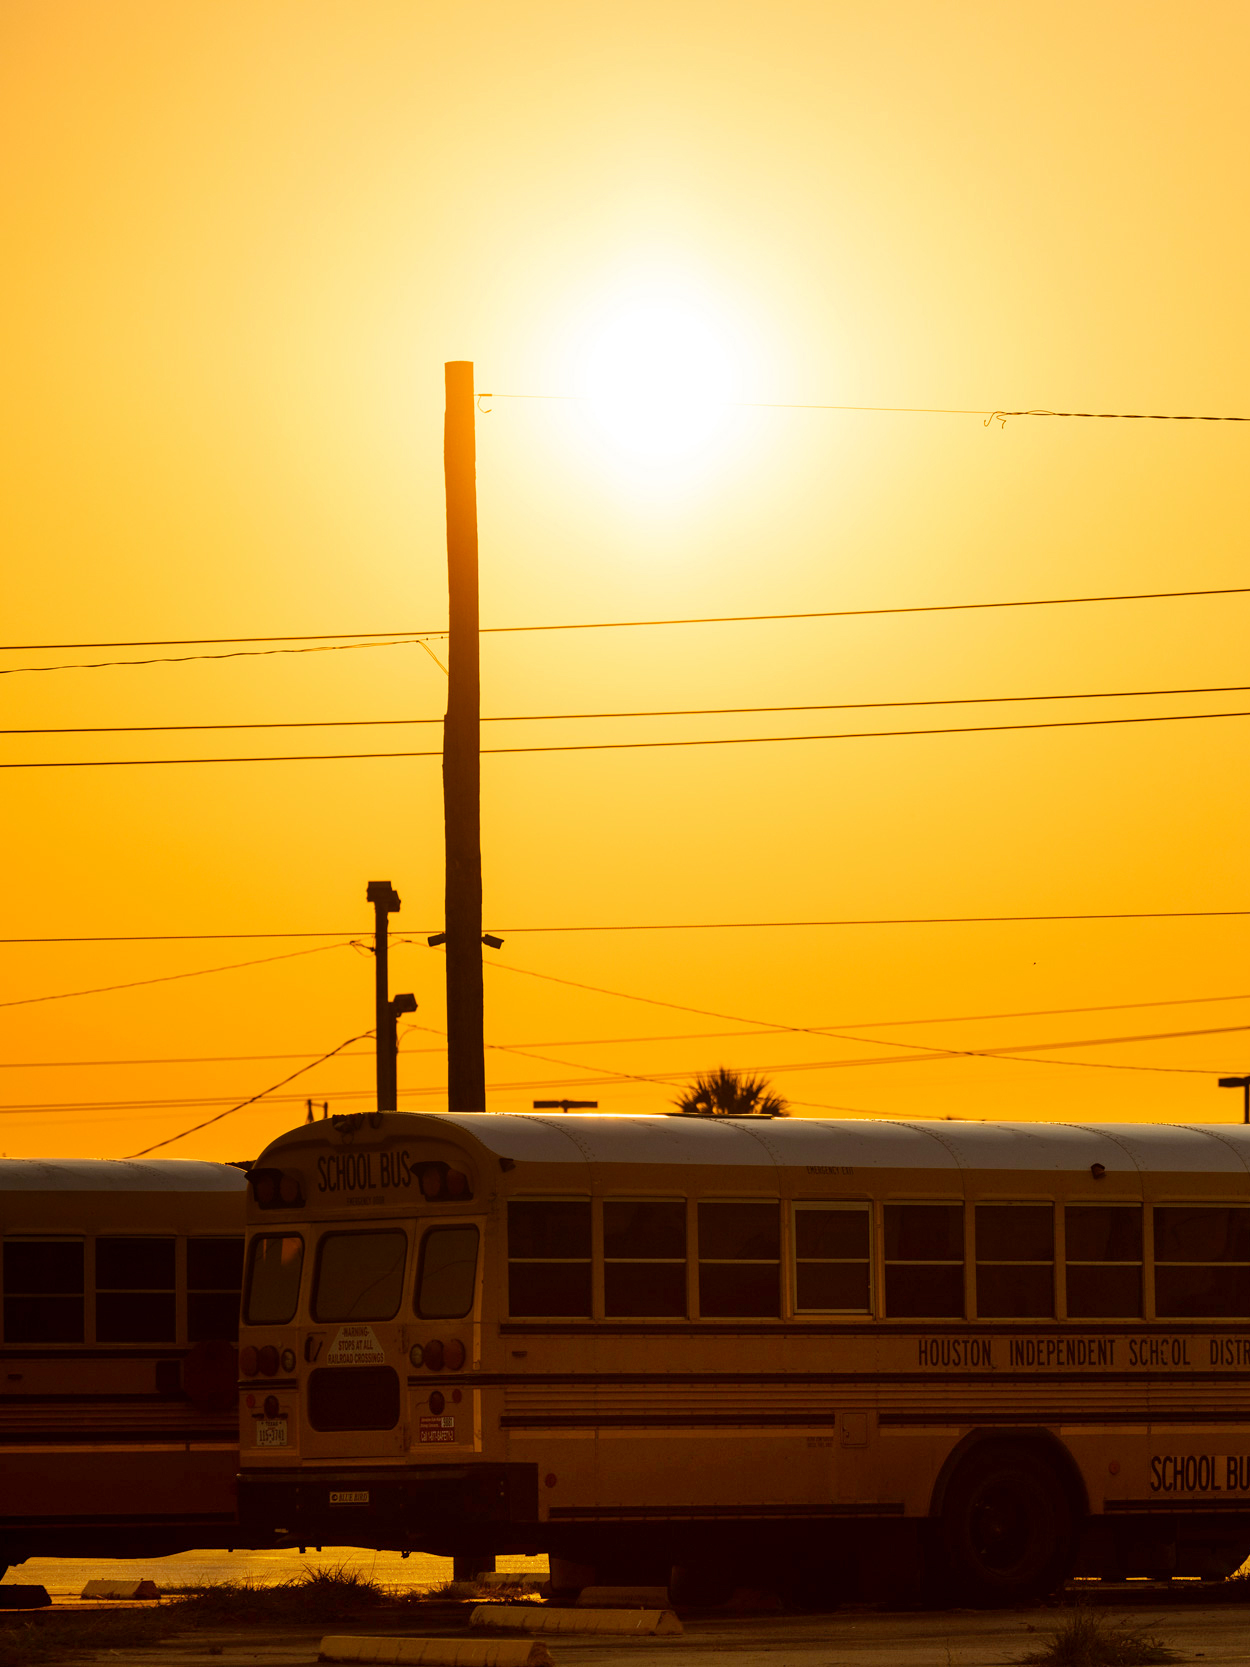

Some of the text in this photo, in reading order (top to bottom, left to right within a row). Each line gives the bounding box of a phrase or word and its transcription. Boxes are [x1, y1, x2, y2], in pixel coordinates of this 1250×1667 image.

[317, 1150, 411, 1192] SCHOOL BUS
[806, 1165, 840, 1175] EMERGENCY
[338, 1340, 374, 1351] STOPS AT ALL
[918, 1338, 992, 1367] HOUSTON
[1009, 1339, 1116, 1366] INDEPENDENT
[328, 1353, 384, 1364] RAILROAD CROSSINGS
[1150, 1455, 1222, 1492] SCHOOL
